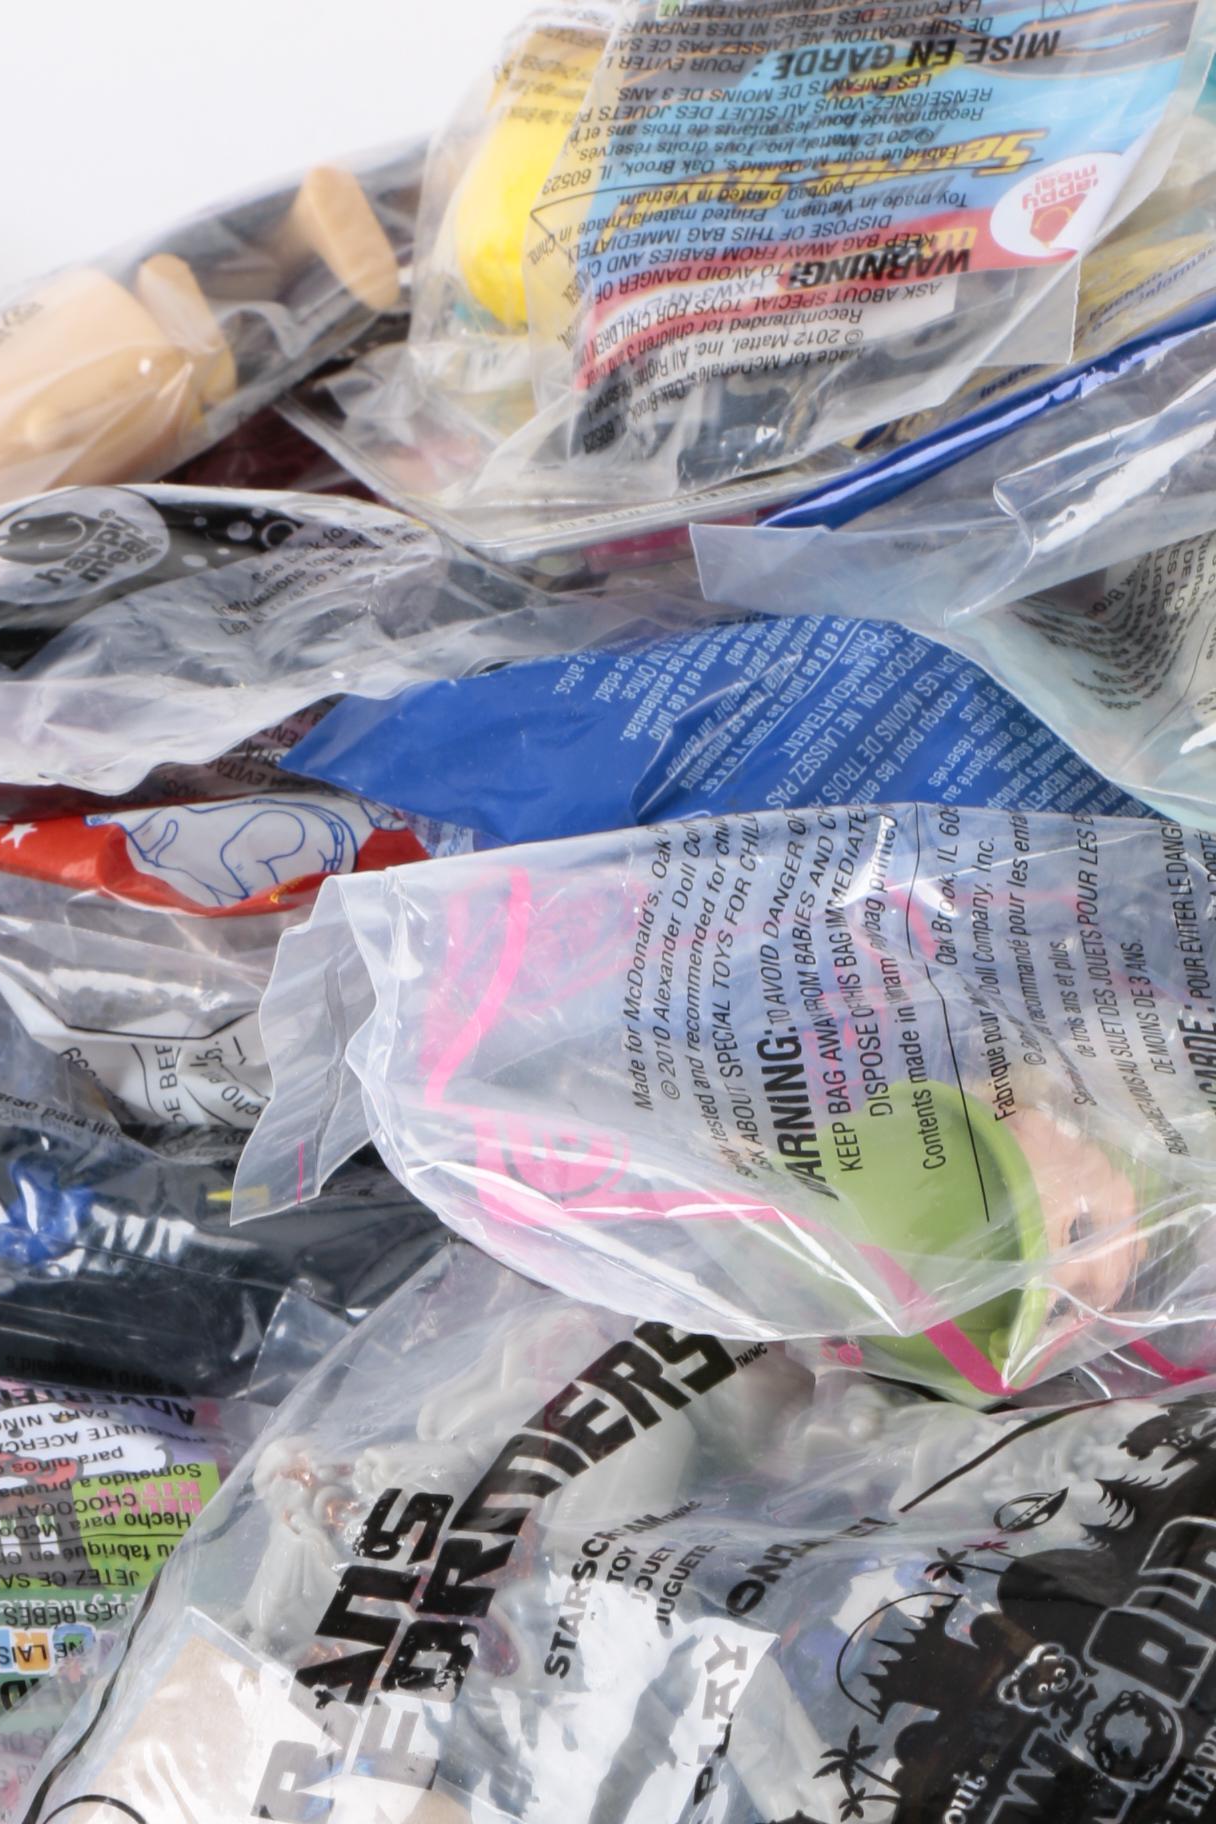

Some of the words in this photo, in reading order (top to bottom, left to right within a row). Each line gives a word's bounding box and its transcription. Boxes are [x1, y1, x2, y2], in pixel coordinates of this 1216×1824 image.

[769, 43, 896, 80] GARDE
[906, 37, 957, 67] EN
[968, 30, 1061, 62] MISE
[599, 105, 671, 120] JOUETS
[677, 105, 713, 119] DES
[718, 104, 777, 121] SUJET
[780, 101, 808, 117] AU
[1021, 178, 1098, 210] appy
[686, 227, 721, 242] BAG
[727, 225, 774, 242] THIS
[779, 224, 805, 240] OF
[812, 215, 891, 237] DISPOSE
[885, 233, 935, 250] KEEP
[649, 245, 717, 265] BABIES
[723, 245, 775, 260] FROM
[783, 239, 838, 259] AWAY
[844, 234, 879, 252] BAG
[607, 252, 646, 272] AND
[699, 264, 752, 281] AVOID
[758, 264, 783, 279] TO
[790, 248, 971, 288] WARNING:
[596, 280, 615, 299] OF
[620, 267, 696, 292] DANGER
[832, 283, 901, 302] ABOUT
[904, 281, 941, 296] ASK
[656, 302, 689, 322] FOR
[694, 299, 743, 315] TOYS
[752, 290, 827, 309] SPECIAL
[650, 839, 671, 879] Oak
[805, 834, 835, 887] AND
[1075, 830, 1097, 866] LES
[670, 860, 698, 908] Doll
[725, 875, 753, 924] FOR
[762, 837, 805, 938] DANGER
[1077, 872, 1100, 928] POUR
[797, 892, 816, 966] BABIES
[620, 887, 662, 1021] McDonald's,
[650, 912, 685, 1022] Alexander
[679, 895, 717, 1051] recommended
[703, 858, 727, 892] for
[711, 930, 733, 988] TOYS
[1087, 930, 1117, 990] JOUETS
[761, 945, 787, 1007] AVOID
[898, 1008, 921, 1031] in
[1097, 990, 1121, 1020] DES
[625, 1029, 643, 1054] for
[653, 1028, 675, 1077] 2010
[714, 1000, 743, 1080] SPECIAL
[1104, 1021, 1133, 1061] SUJET
[858, 1025, 892, 1120] DISPOSE
[903, 1032, 933, 1088] made
[912, 1091, 945, 1172] Contents
[371, 1319, 738, 1791] FORMERS
[602, 1543, 638, 1587] TOY
[647, 1534, 715, 1628] JUGUETE
